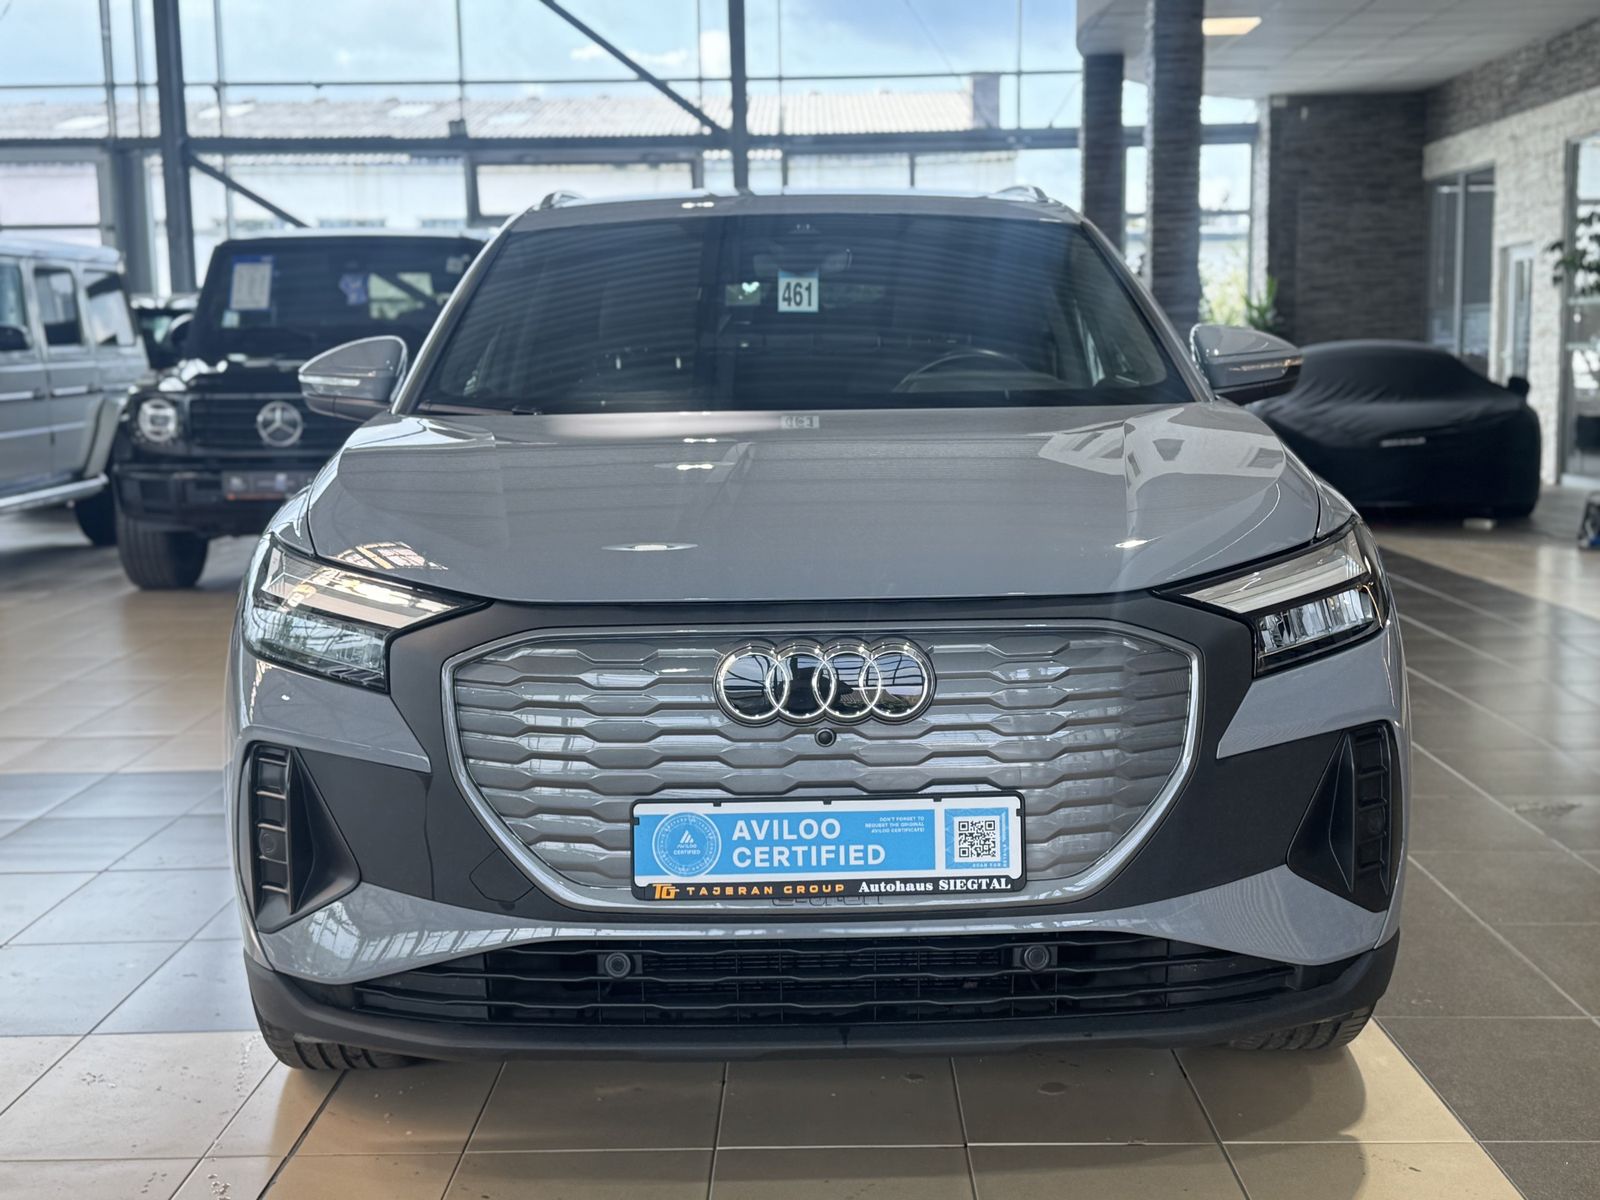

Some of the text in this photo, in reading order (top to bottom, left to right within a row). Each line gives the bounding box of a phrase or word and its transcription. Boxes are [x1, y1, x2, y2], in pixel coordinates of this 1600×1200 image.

[782, 281, 812, 307] 461
[731, 817, 841, 842] AVILOO
[732, 844, 886, 868] CERTIFIED
[783, 883, 845, 895] GROUP
[858, 877, 1011, 893] Autohaus SIEGTAL
